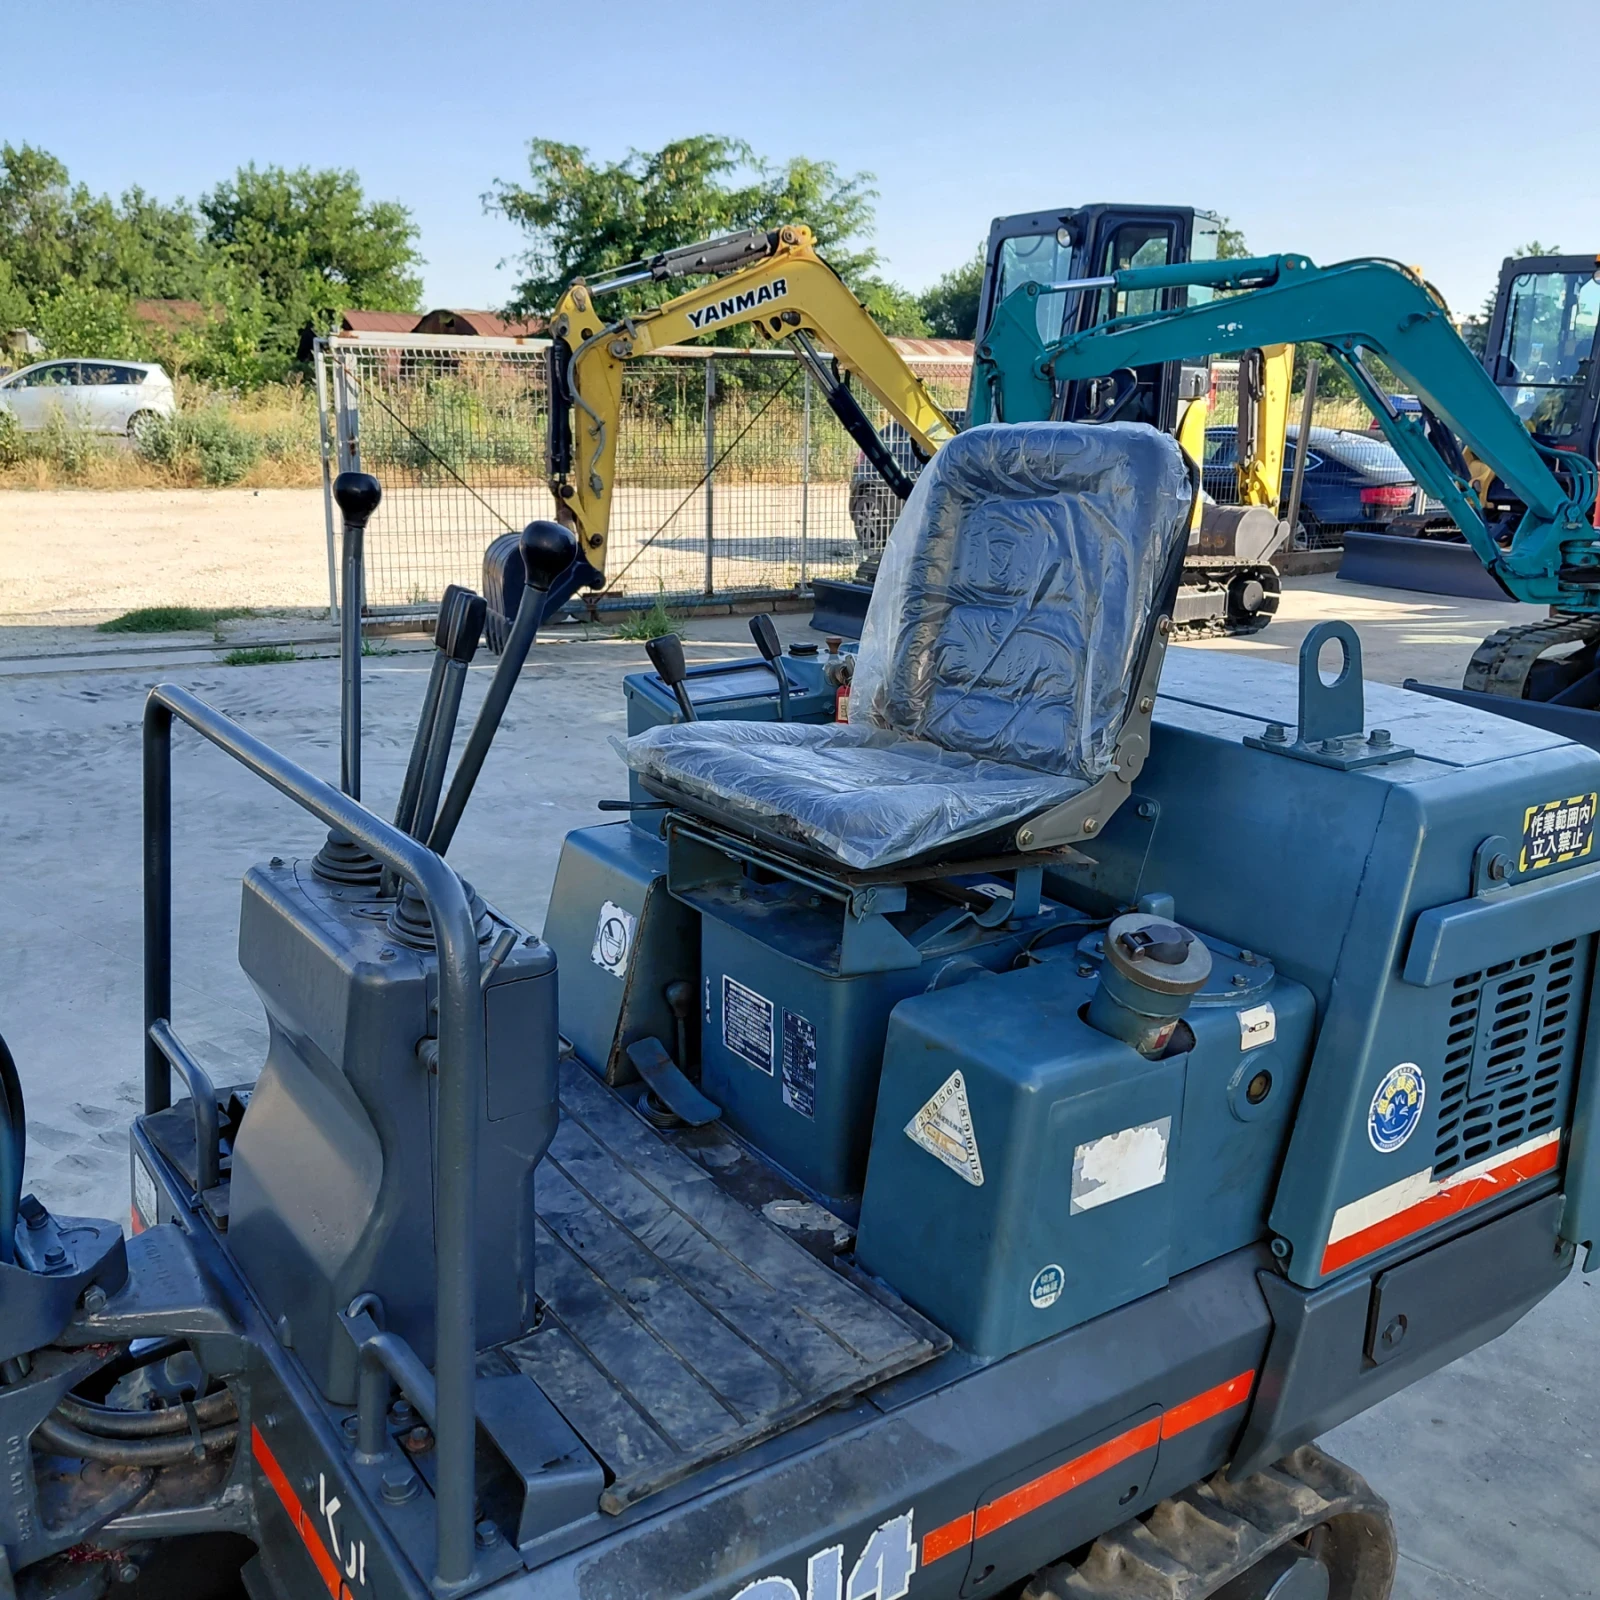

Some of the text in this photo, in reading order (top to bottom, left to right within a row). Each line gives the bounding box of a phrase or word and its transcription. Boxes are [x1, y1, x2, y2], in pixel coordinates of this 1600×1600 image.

[687, 278, 788, 329] YANMAR
[1531, 805, 1591, 838] 作業範囲内
[1530, 828, 1583, 859] 立入禁止
